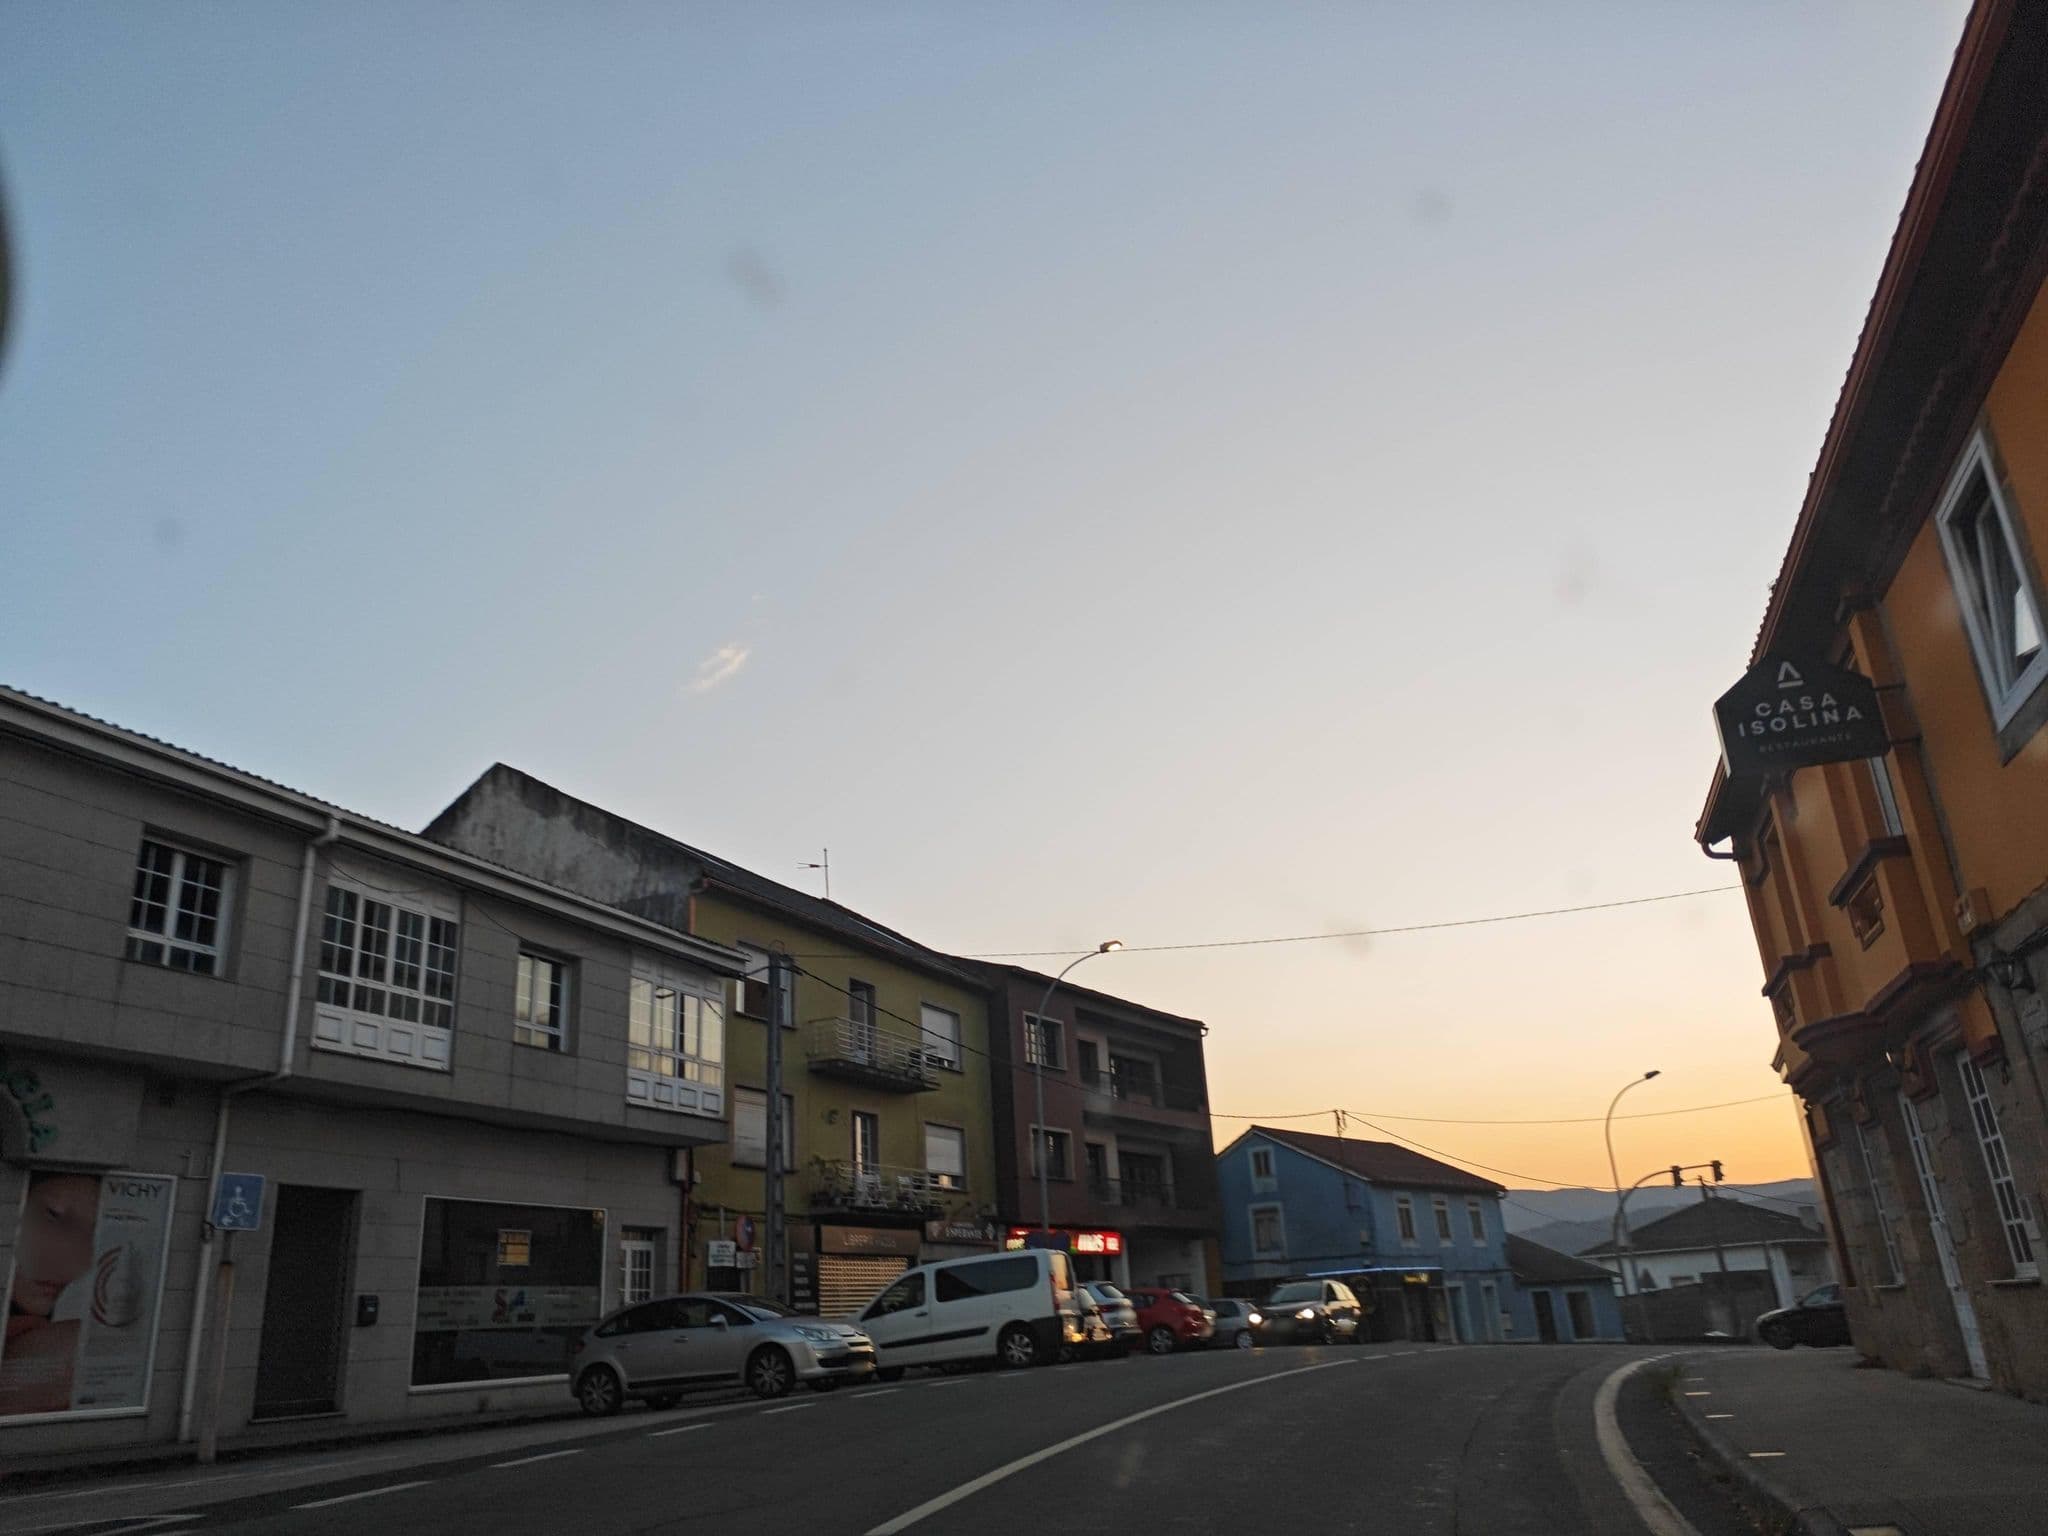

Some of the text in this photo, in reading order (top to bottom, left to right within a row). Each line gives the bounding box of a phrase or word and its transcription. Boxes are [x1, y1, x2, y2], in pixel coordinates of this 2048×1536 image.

[1756, 693, 1838, 718] CASA
[1738, 705, 1863, 738] ISOLINA
[110, 1181, 162, 1198] VICHY
